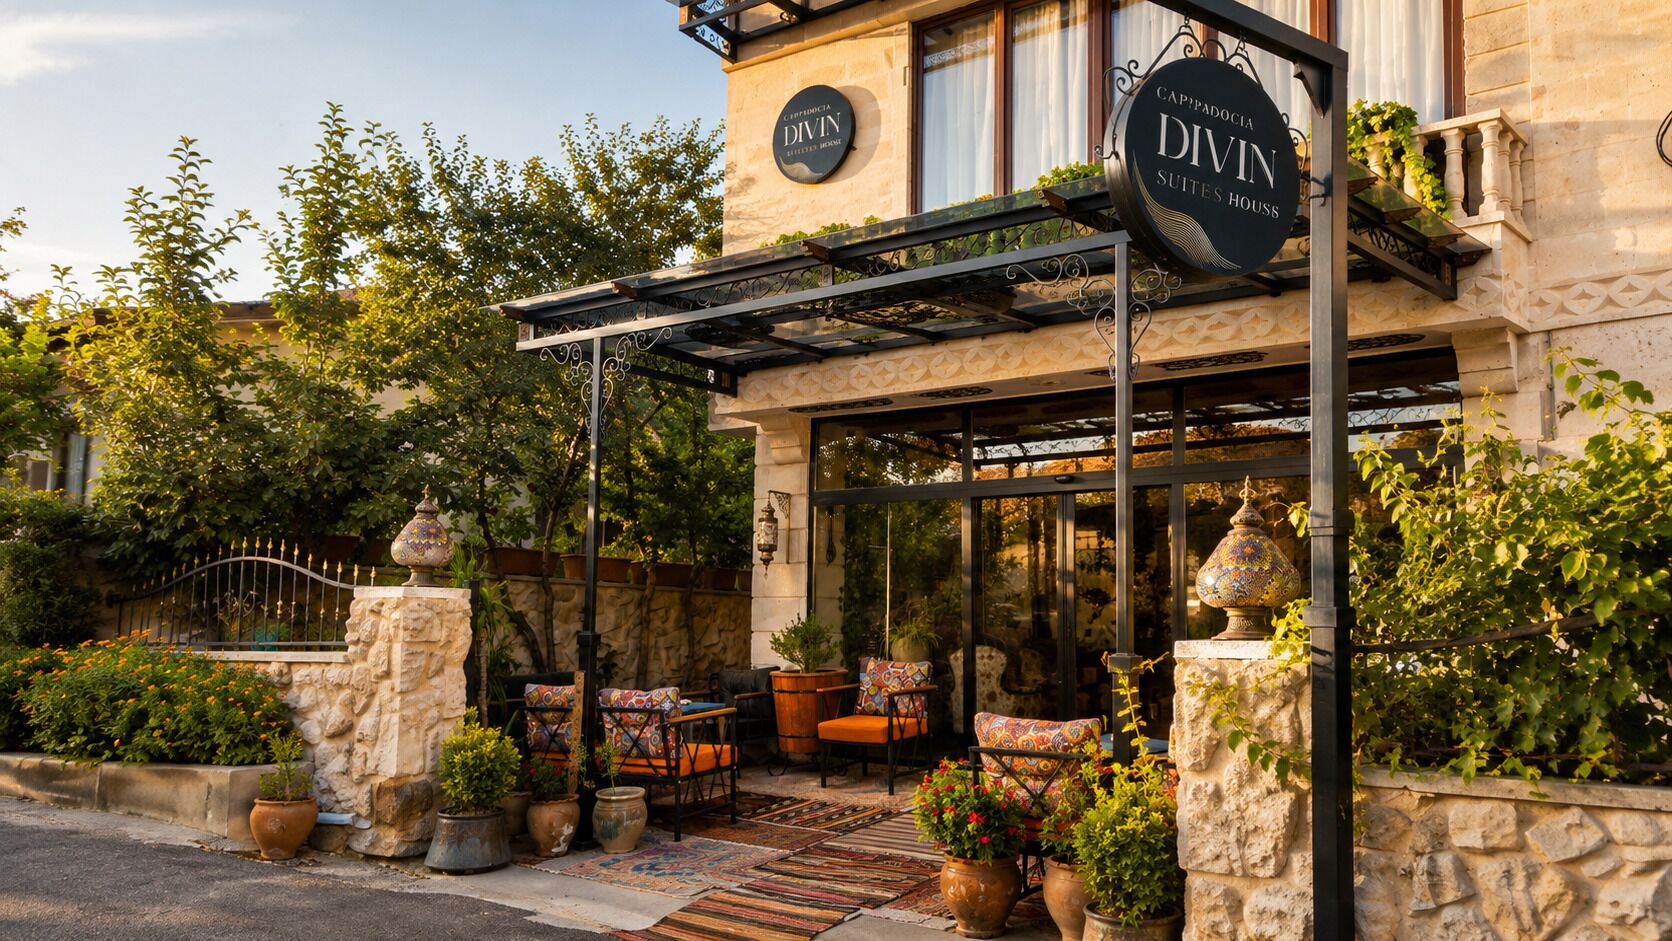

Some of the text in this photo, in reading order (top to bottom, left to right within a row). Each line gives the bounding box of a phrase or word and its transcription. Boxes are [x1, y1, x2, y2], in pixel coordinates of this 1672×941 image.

[783, 112, 841, 147] DIVIN
[1157, 112, 1277, 190] DIVIN
[1157, 169, 1222, 202] SUITES
